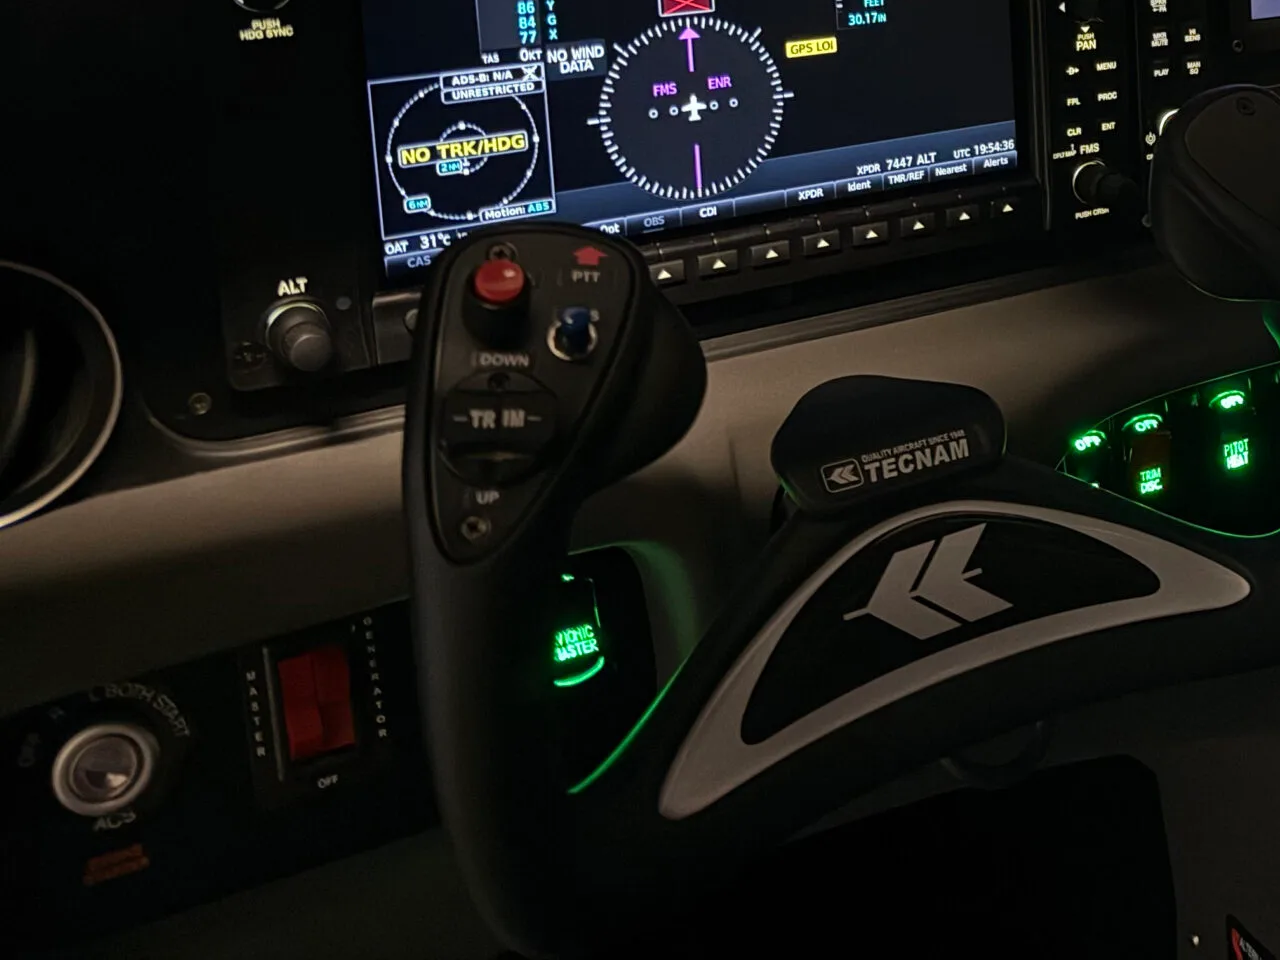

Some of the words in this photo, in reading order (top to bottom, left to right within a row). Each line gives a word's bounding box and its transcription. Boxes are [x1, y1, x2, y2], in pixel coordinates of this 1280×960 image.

[517, 0, 535, 14] 86
[546, 0, 554, 11] Y
[251, 18, 280, 30] PUSH
[518, 15, 536, 29] 84
[547, 13, 557, 25] G
[239, 28, 263, 40] HDG
[519, 30, 536, 44] 77
[549, 28, 558, 40] X
[1077, 32, 1095, 40] PUSH
[790, 43, 813, 55] GPS
[816, 40, 834, 52] LOI
[1076, 40, 1096, 52] PAN
[482, 53, 500, 64] TAS
[547, 48, 568, 63] NO
[571, 44, 604, 60] WIND
[560, 58, 594, 74] DATA
[1096, 61, 1117, 71] MENU
[492, 70, 513, 82] N/A
[708, 76, 731, 90] ENR
[452, 82, 535, 100] UNRESTRICTED
[653, 83, 677, 97] FMS
[1098, 91, 1117, 101] PROC
[1067, 98, 1081, 106] FPL
[1067, 127, 1082, 136] CLR
[1101, 122, 1116, 131] ENT
[401, 148, 431, 165] NO
[437, 135, 525, 160] TRK/HDG
[1080, 143, 1100, 154] FMS
[856, 163, 881, 175] XPDR
[886, 156, 913, 170] 7447
[917, 152, 937, 166] ALT
[953, 148, 971, 159] UTC
[973, 140, 1015, 155] 19:54:36
[983, 156, 1009, 169] Alerts
[935, 163, 968, 177] Nearest
[848, 179, 872, 192] Ident
[798, 187, 824, 201] XPDR
[485, 206, 525, 219] Motion:
[527, 202, 550, 214] ABS
[699, 206, 717, 218] CDI
[643, 216, 665, 227] OBS
[384, 241, 408, 255] OAT
[407, 256, 431, 268] CAS
[572, 270, 600, 283] PTT
[277, 276, 308, 296] ALT
[480, 352, 529, 367] DOWN
[1134, 418, 1159, 432] OFF
[861, 447, 892, 463] QUALITY
[893, 439, 927, 455] AIRCRAFT
[928, 432, 950, 446] SINCE
[1074, 434, 1102, 451] OFF
[1223, 438, 1249, 458] PITOT
[864, 437, 970, 483] TECNAM
[1226, 451, 1249, 470] HEAT
[1139, 467, 1162, 482] TRIM
[475, 490, 500, 505] UP
[554, 623, 595, 646] VIONIC
[362, 616, 389, 739] GENERATOR
[104, 683, 155, 702] BOTH
[153, 693, 191, 736] START
[245, 670, 267, 758] MASTER
[316, 773, 339, 789] OFF
